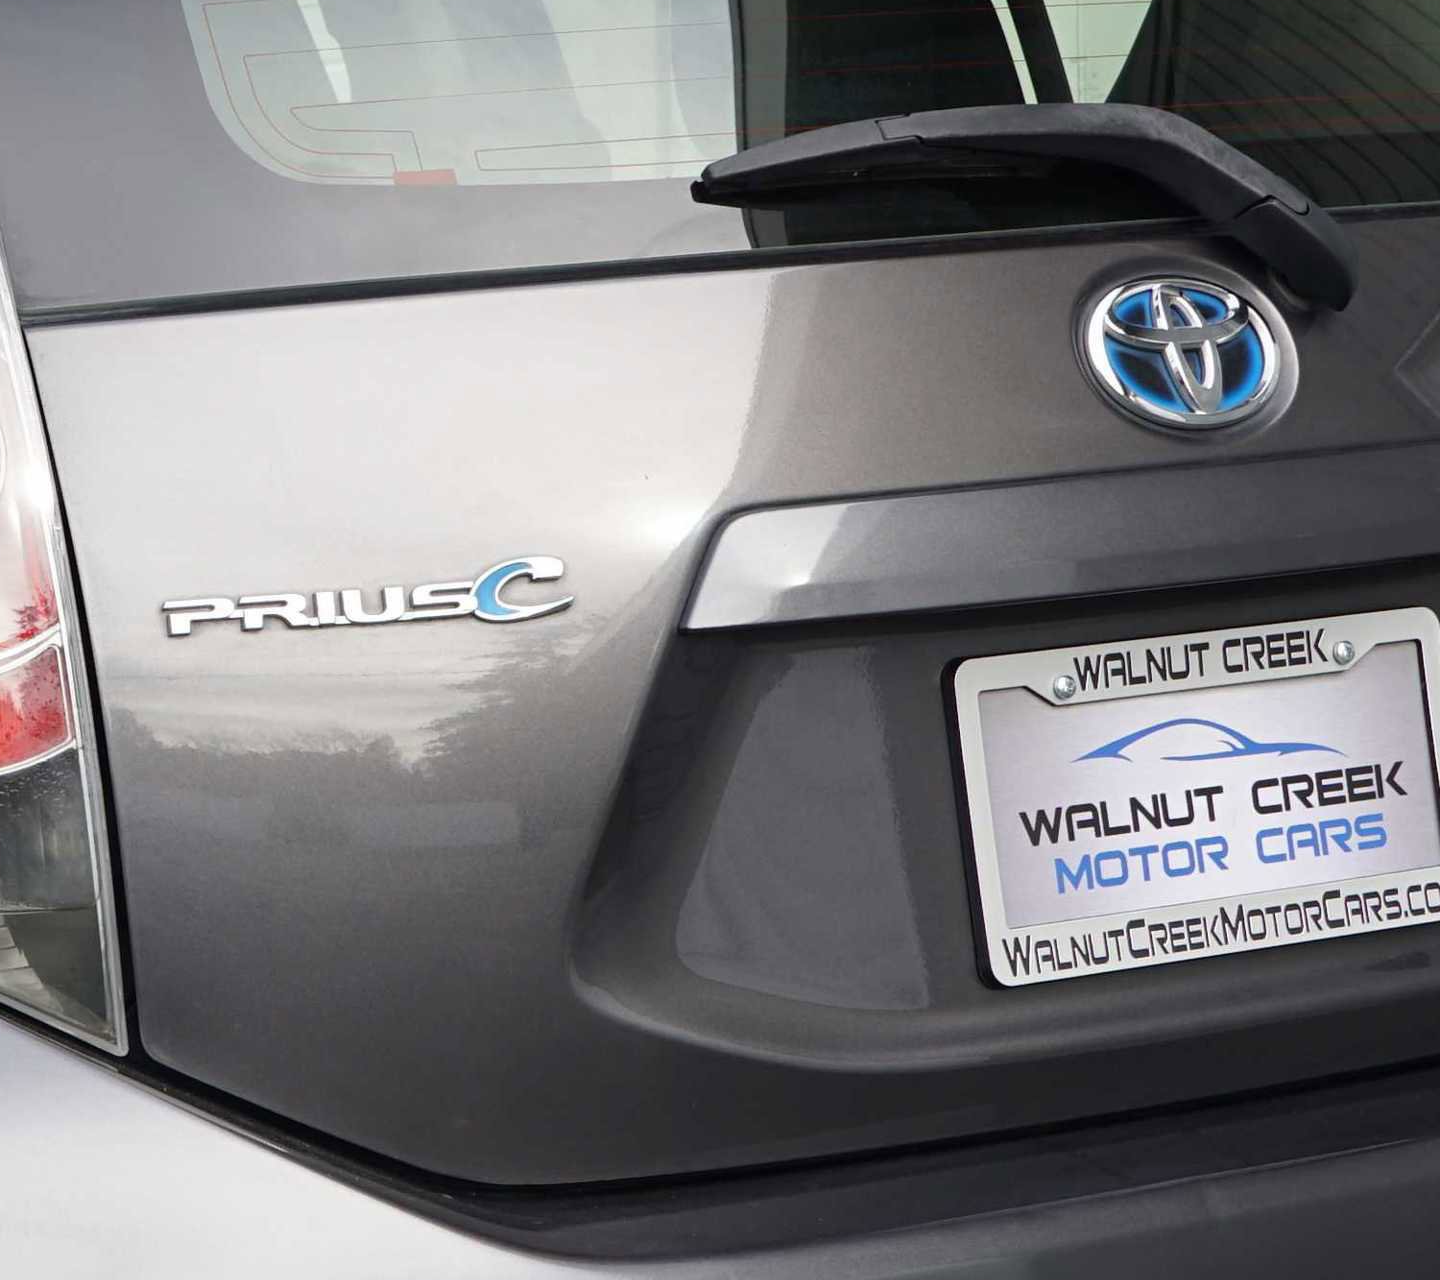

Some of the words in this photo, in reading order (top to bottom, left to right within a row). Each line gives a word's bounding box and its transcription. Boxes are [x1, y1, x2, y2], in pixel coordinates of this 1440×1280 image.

[1073, 642, 1210, 691] WALNUT
[1222, 628, 1329, 674] CREEK
[1019, 785, 1224, 847] WALNUT
[1251, 761, 1408, 815] CREEK
[1054, 835, 1229, 895] MOTOR
[1256, 813, 1388, 864] CARS
